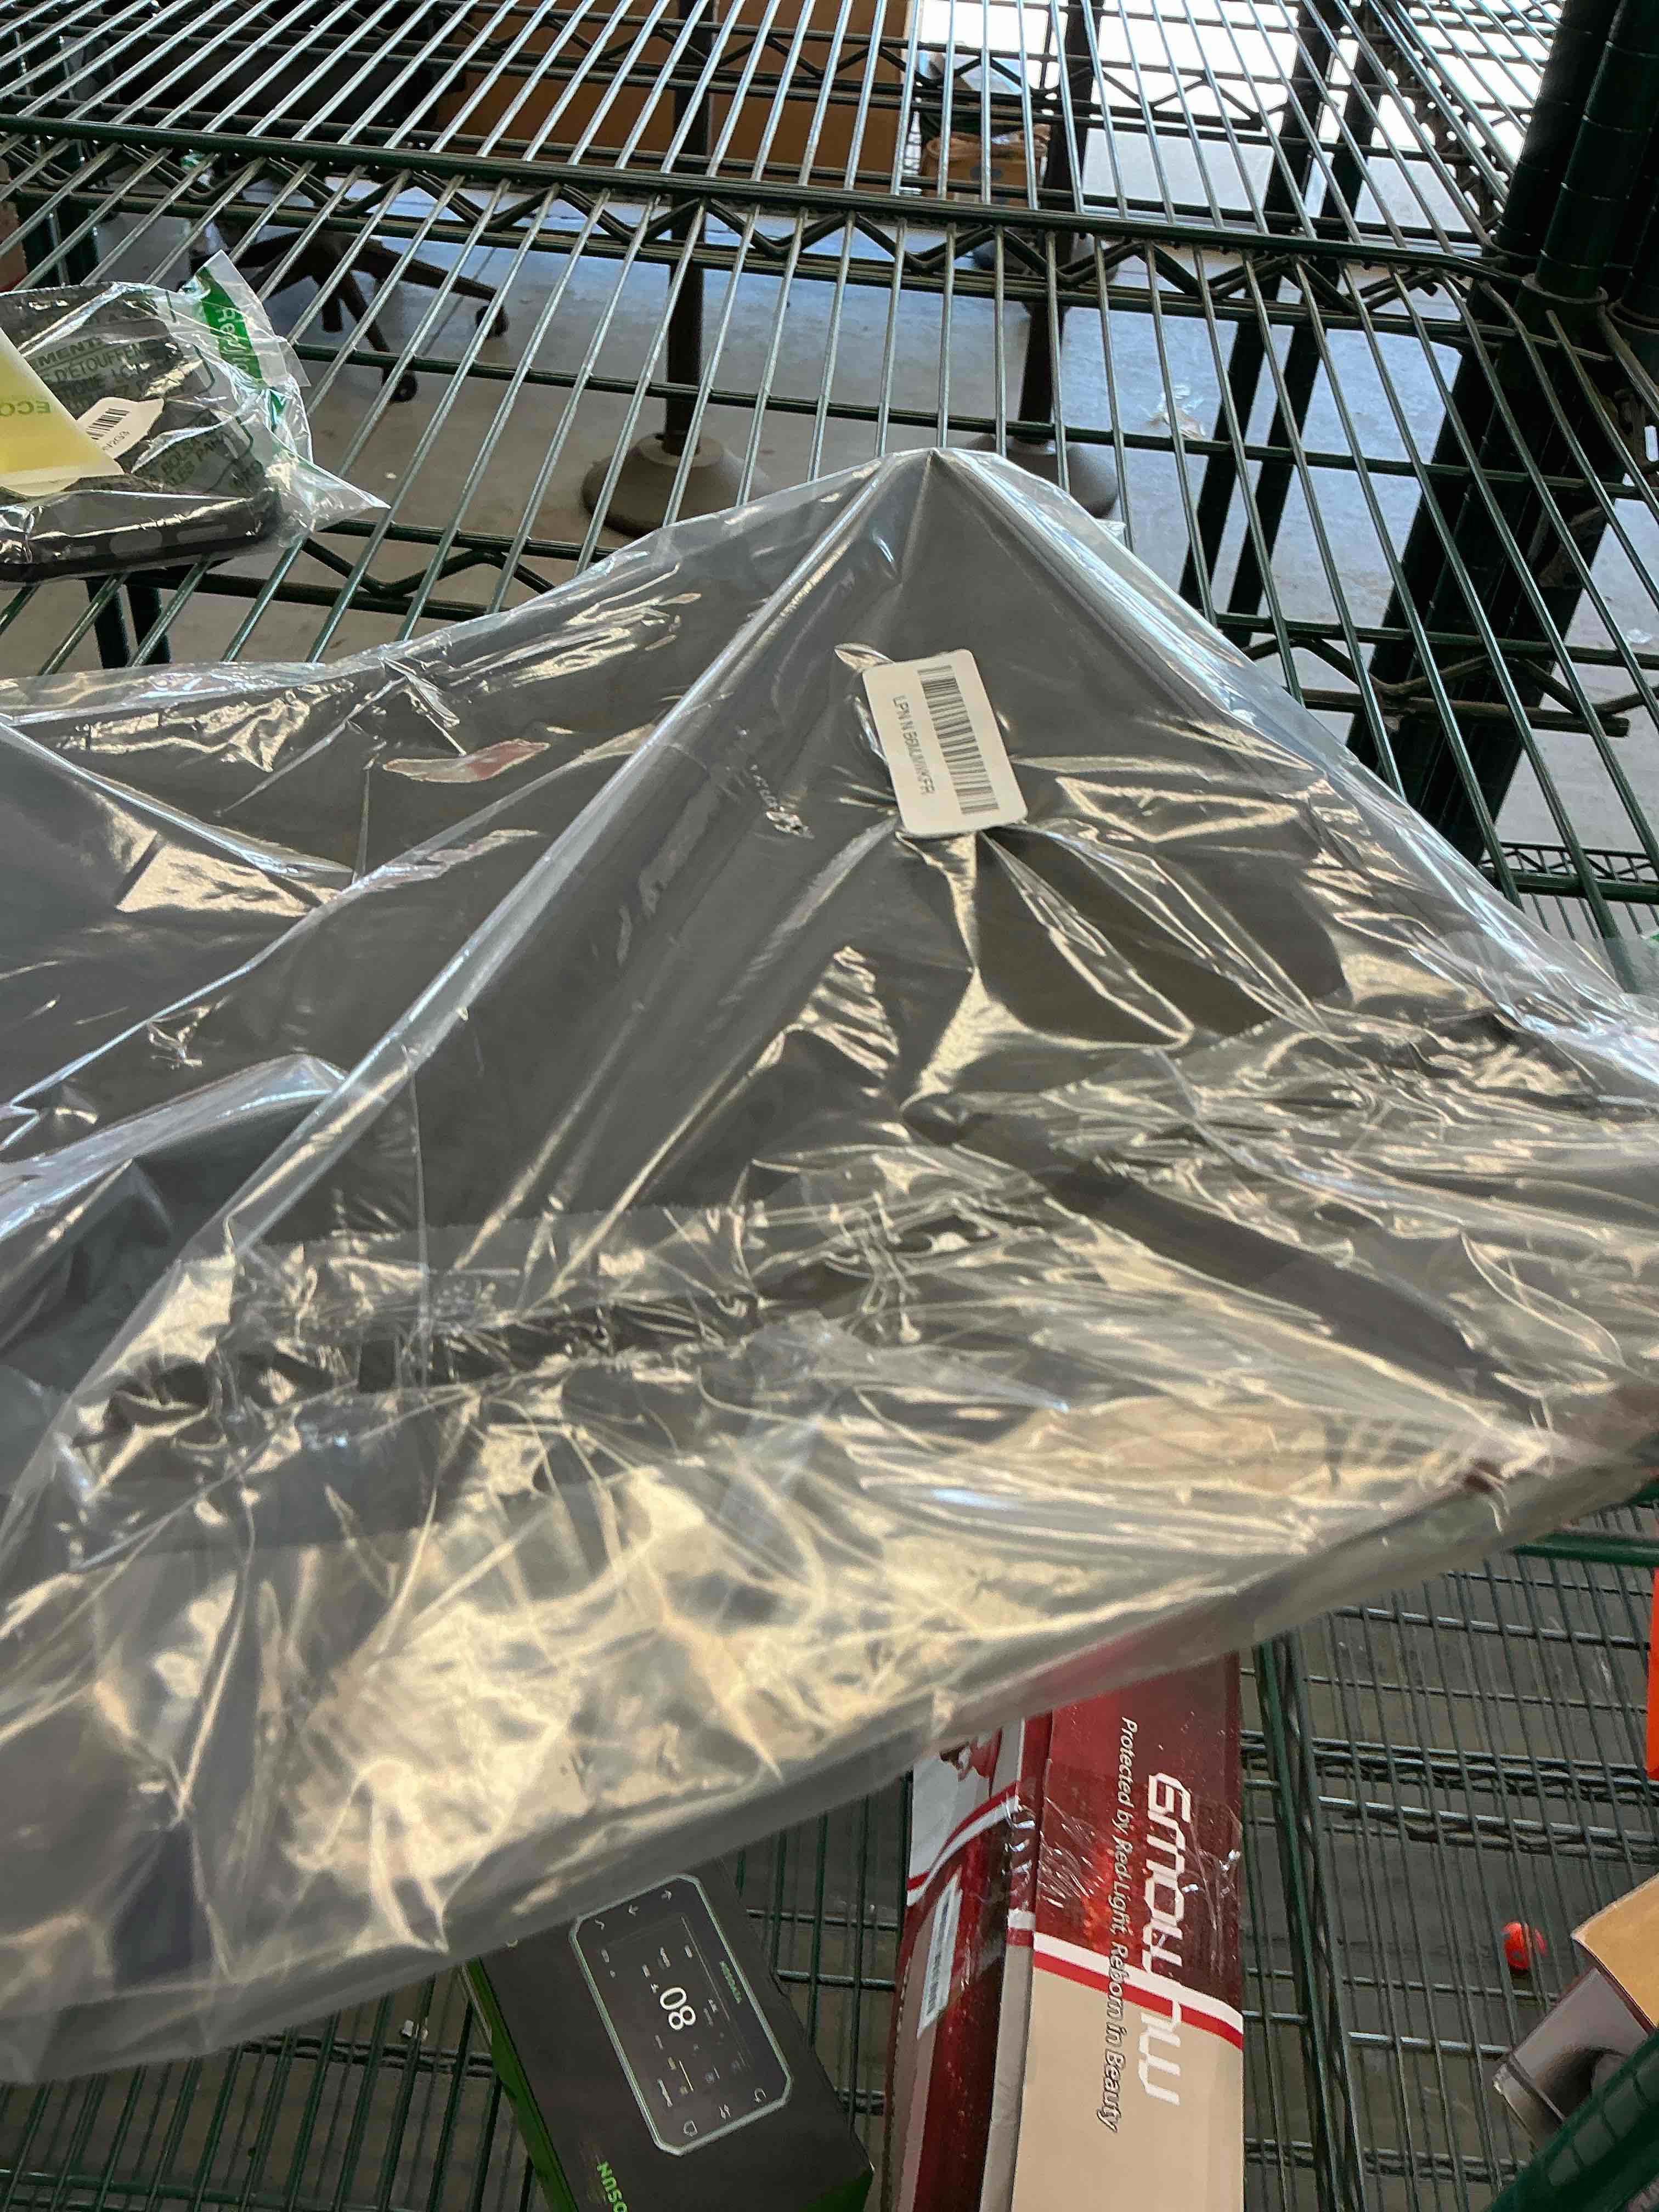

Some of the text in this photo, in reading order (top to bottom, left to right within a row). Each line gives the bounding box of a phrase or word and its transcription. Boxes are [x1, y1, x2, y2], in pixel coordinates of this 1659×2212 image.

[1118, 1716, 1138, 1809] Protected
[1111, 1808, 1133, 1836] by
[1111, 1835, 1133, 1881] Red
[1107, 1939, 1131, 2022] Reborn
[1105, 2022, 1127, 2048] in
[1097, 2049, 1126, 2134] Beauty
